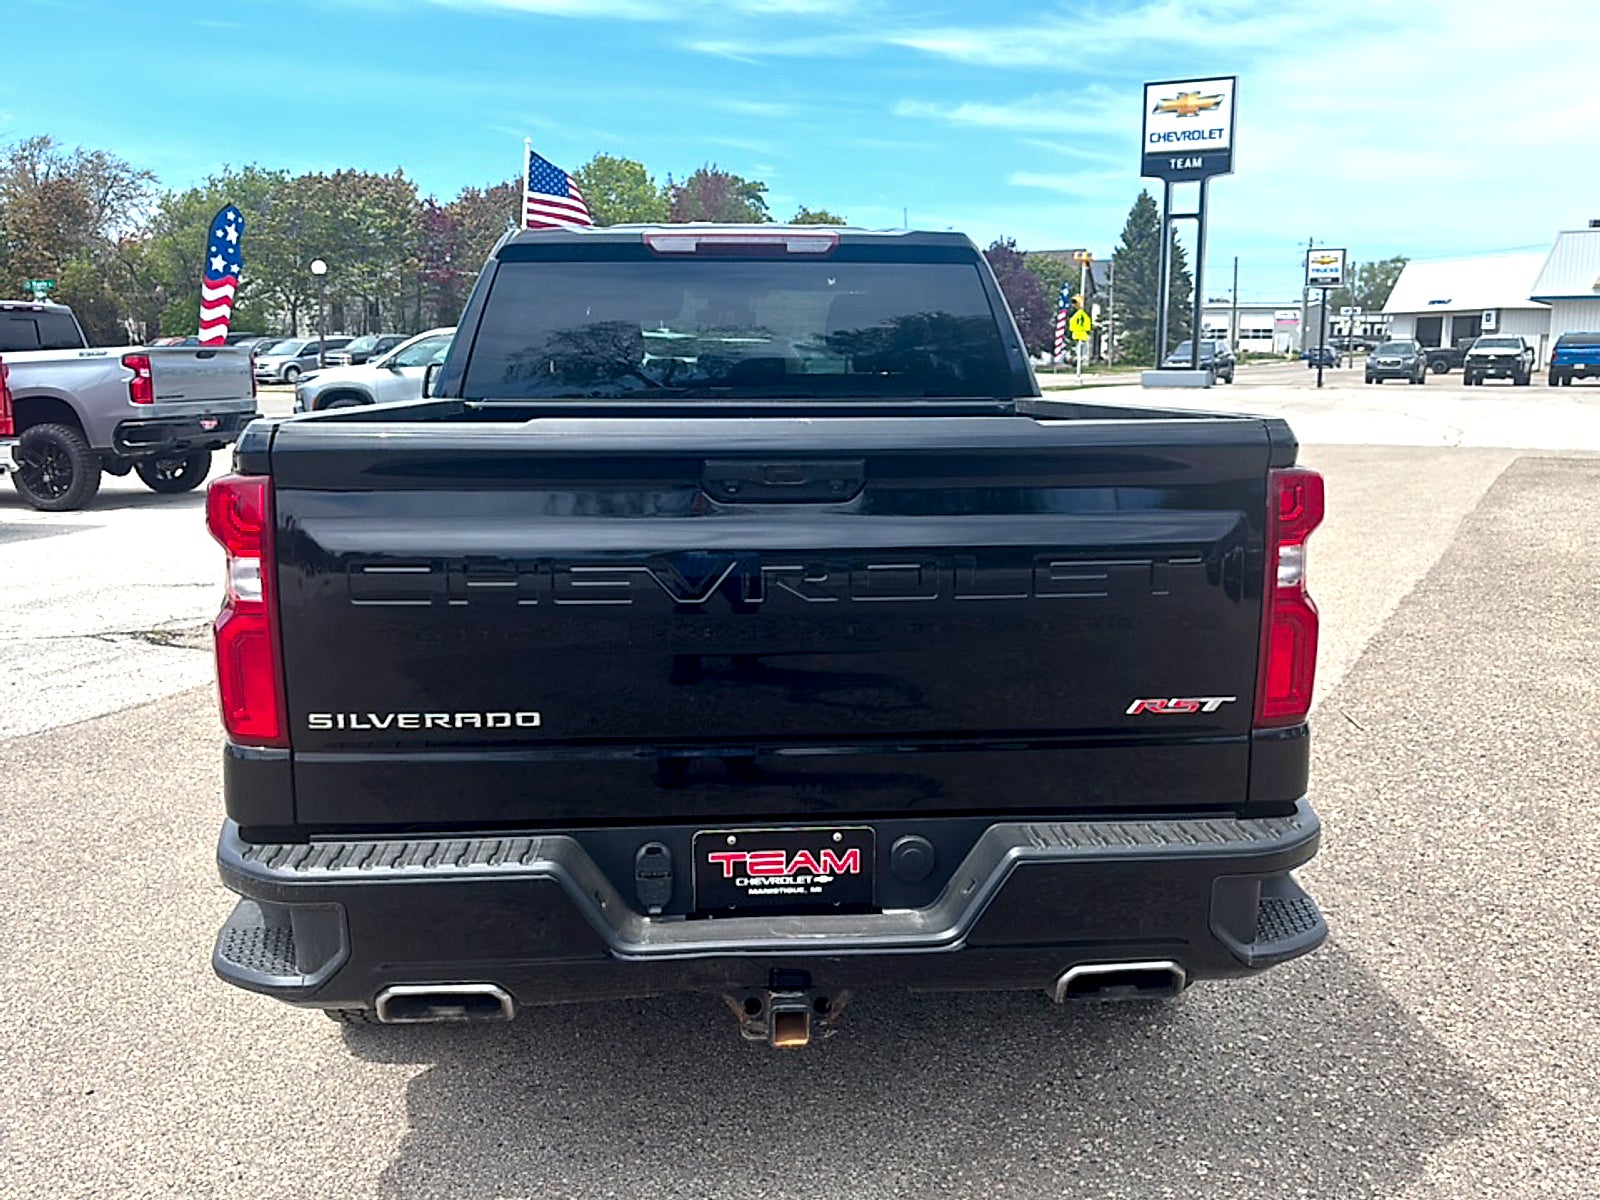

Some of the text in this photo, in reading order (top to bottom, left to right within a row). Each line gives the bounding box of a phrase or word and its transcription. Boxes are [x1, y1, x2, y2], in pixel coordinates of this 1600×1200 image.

[1150, 128, 1224, 143] CHEVROLET
[1169, 158, 1202, 170] TEAM
[348, 557, 1204, 606] CHEVROLET
[1126, 696, 1237, 715] RST
[308, 712, 541, 730] SILVERADO
[708, 848, 860, 877] TEAM
[735, 875, 813, 886] CHEVROLET
